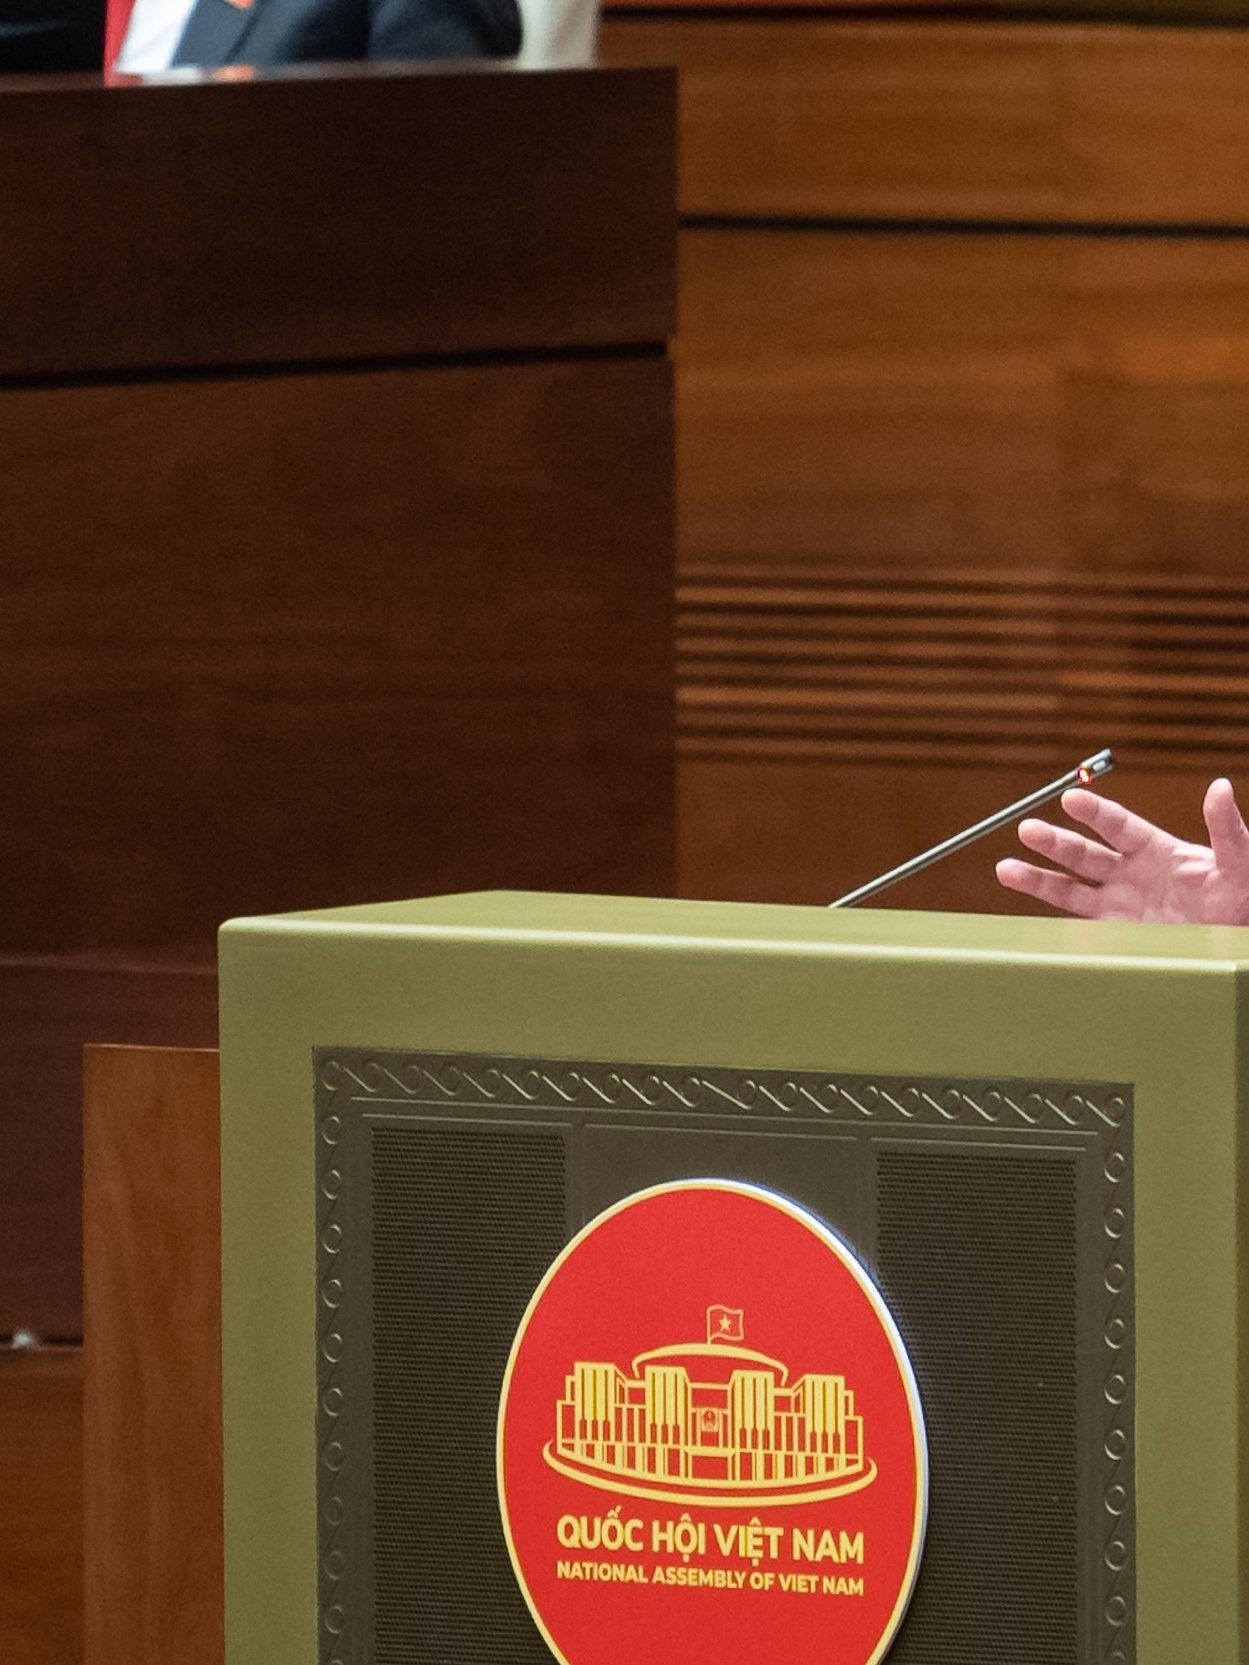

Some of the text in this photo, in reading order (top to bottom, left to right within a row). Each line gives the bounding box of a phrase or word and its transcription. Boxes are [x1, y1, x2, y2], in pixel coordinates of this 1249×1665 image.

[557, 1505, 865, 1567] QUỐC HỘI VIỆT NAM
[557, 1560, 864, 1596] NATIONAL ASSEMBLY OF VIET NAM
